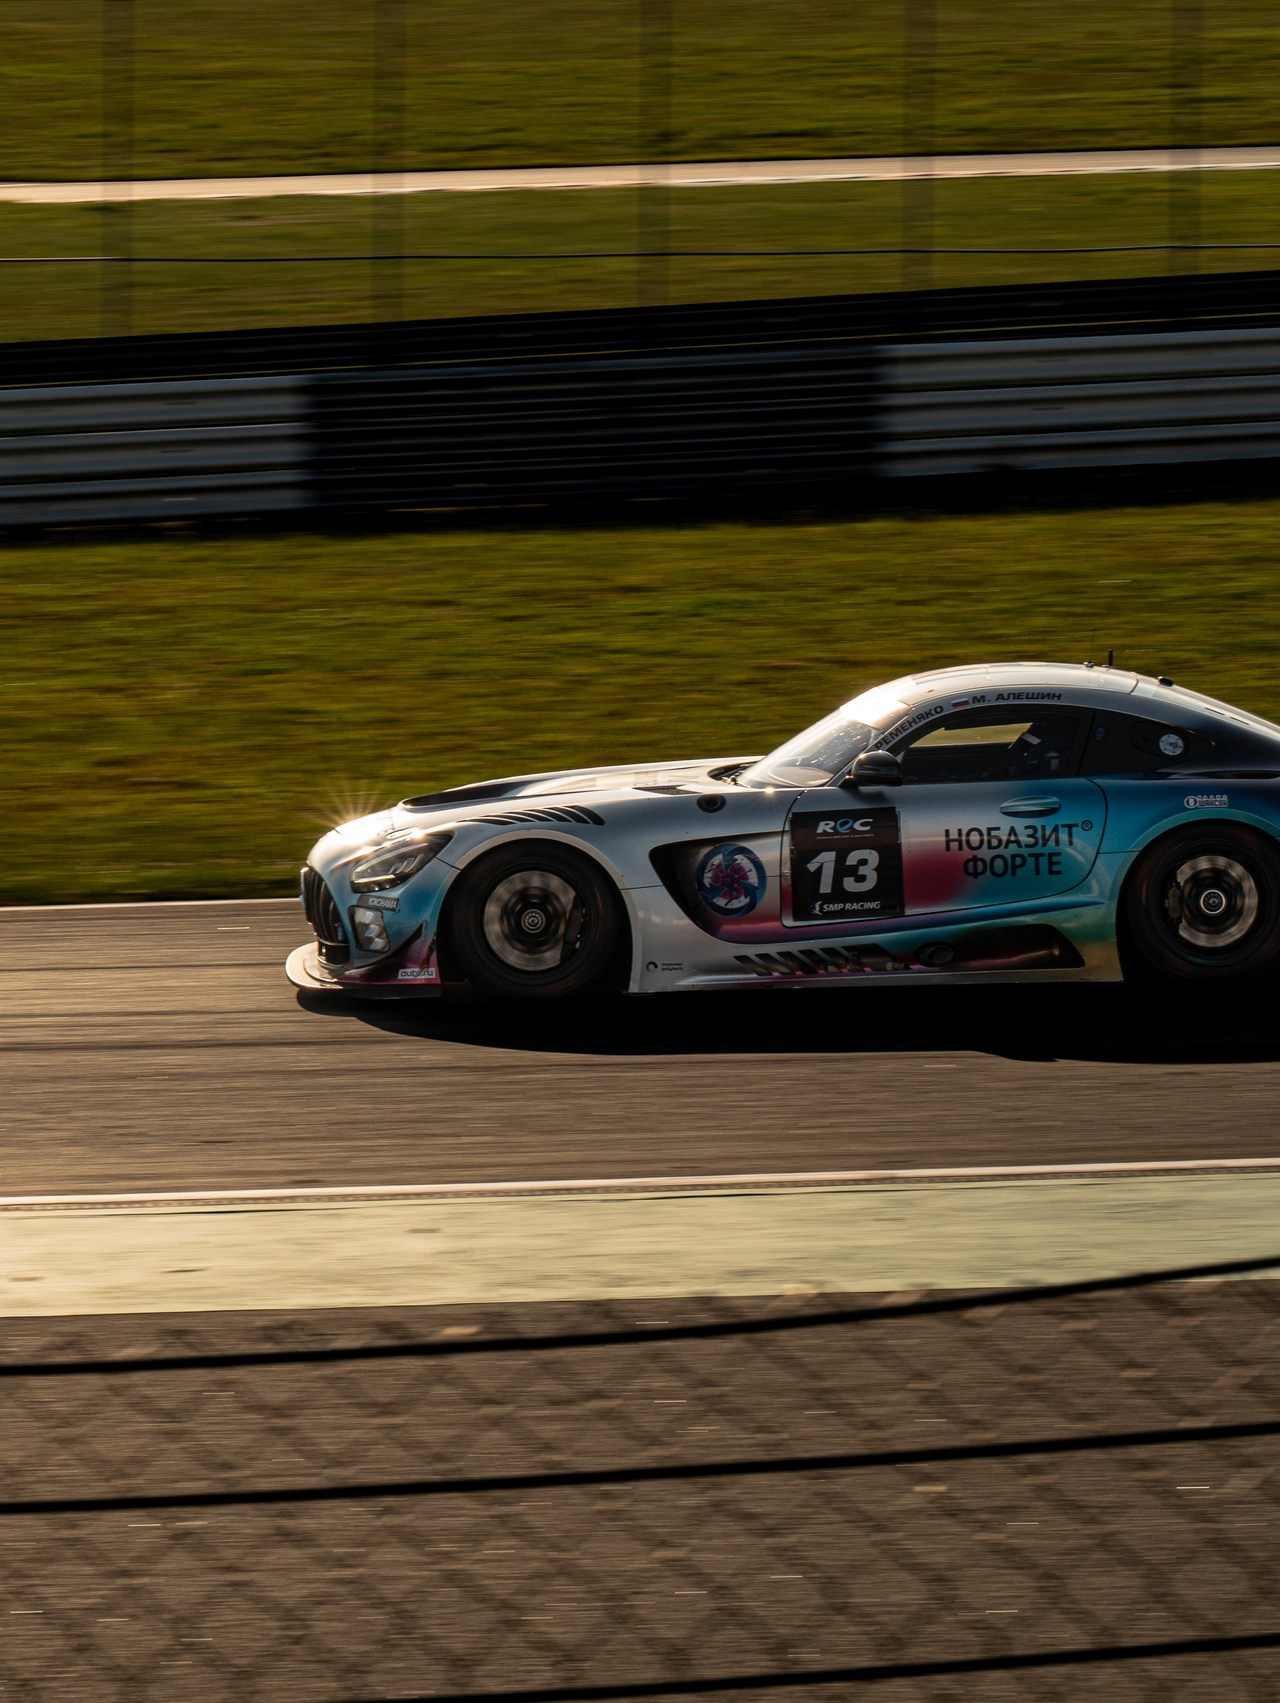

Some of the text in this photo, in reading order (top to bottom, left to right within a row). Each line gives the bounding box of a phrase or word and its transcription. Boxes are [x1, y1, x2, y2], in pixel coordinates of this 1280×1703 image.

[972, 694, 991, 704] М.
[995, 691, 1063, 702] АЛЕШИН
[806, 849, 880, 893] 13
[963, 852, 1062, 879] ФОРТЕ
[823, 901, 880, 912] SMP RACING
